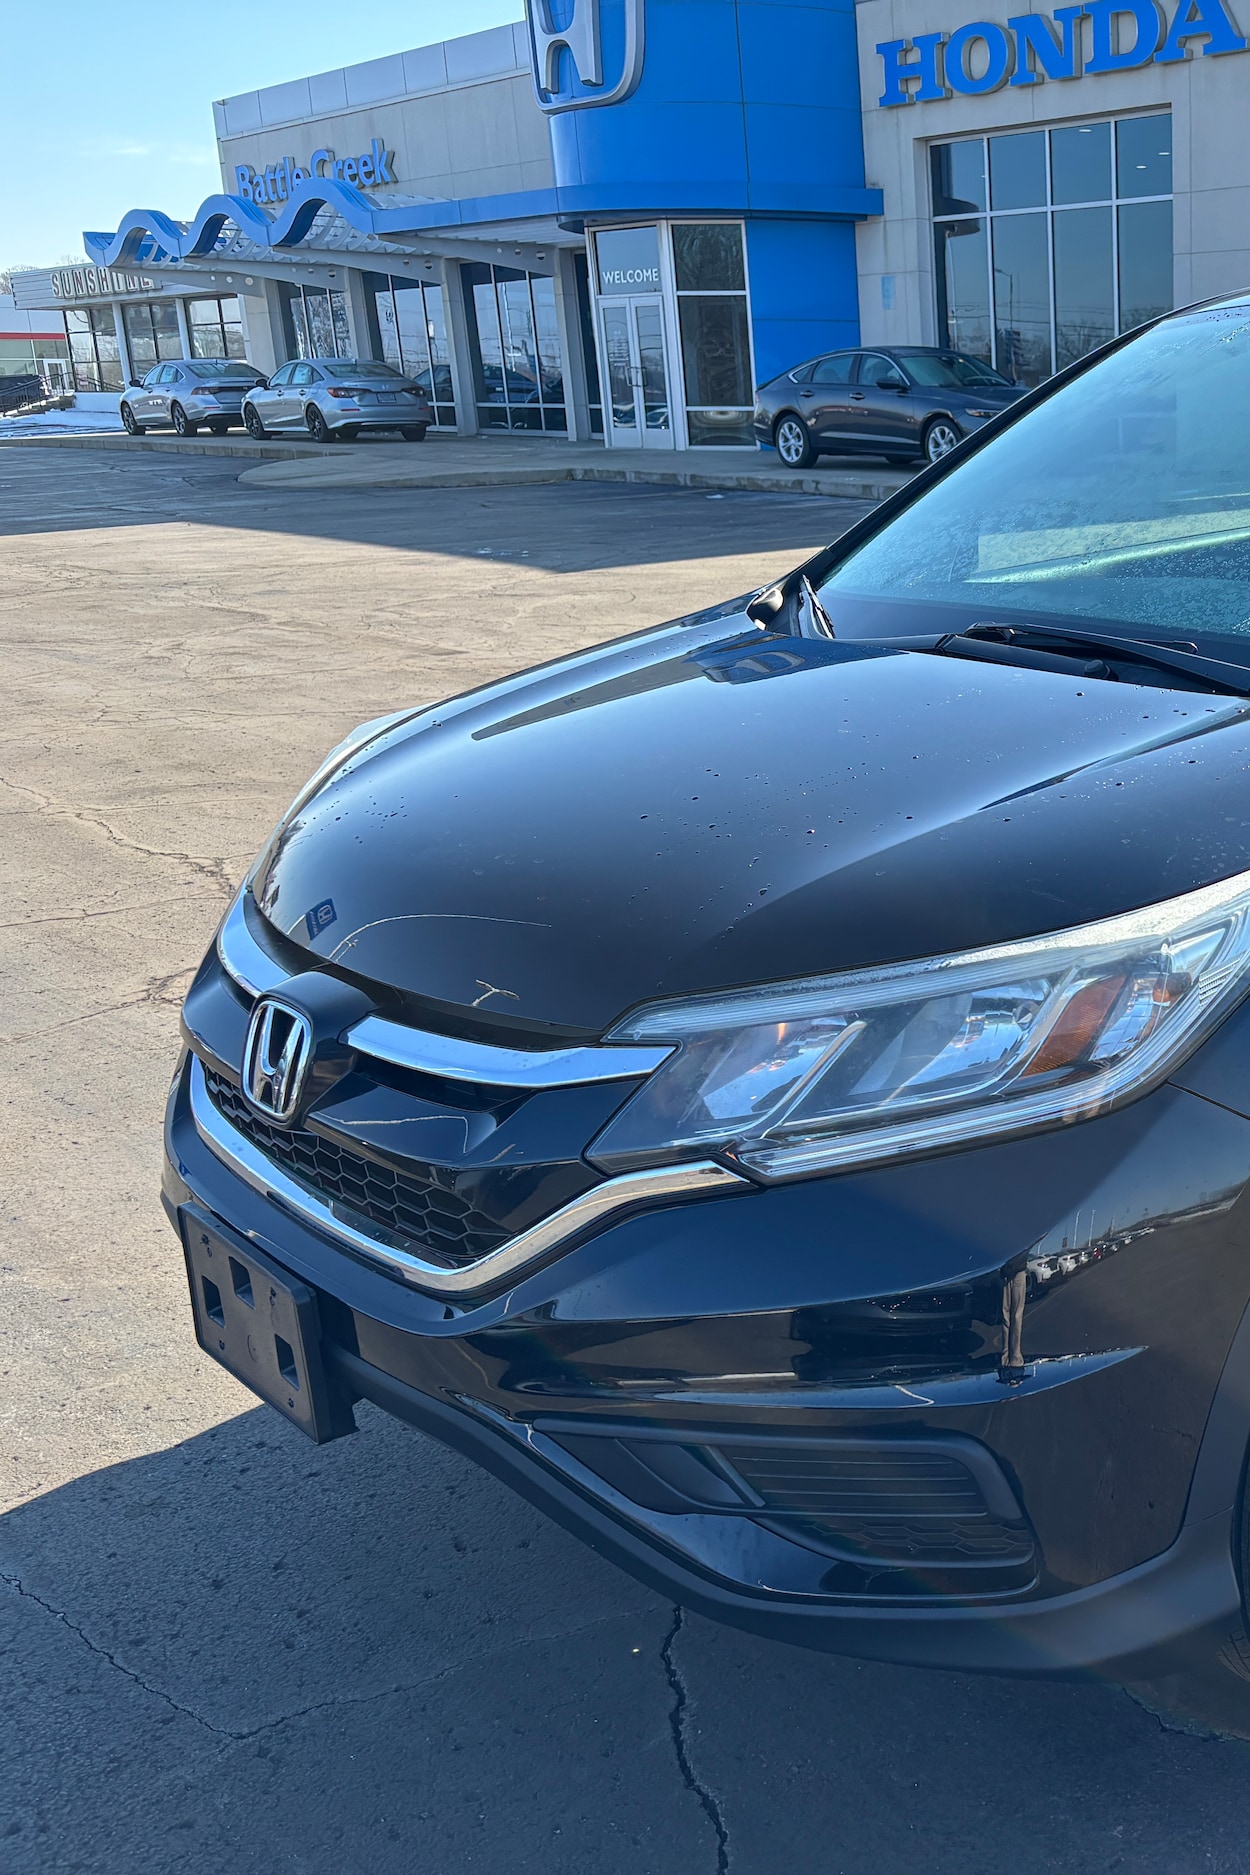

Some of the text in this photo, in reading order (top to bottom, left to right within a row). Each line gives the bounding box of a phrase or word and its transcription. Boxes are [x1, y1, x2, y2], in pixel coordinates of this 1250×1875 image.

[235, 138, 398, 203] Battle Creek
[51, 267, 152, 297] SUNSHINE
[602, 268, 659, 284] WELCOME
